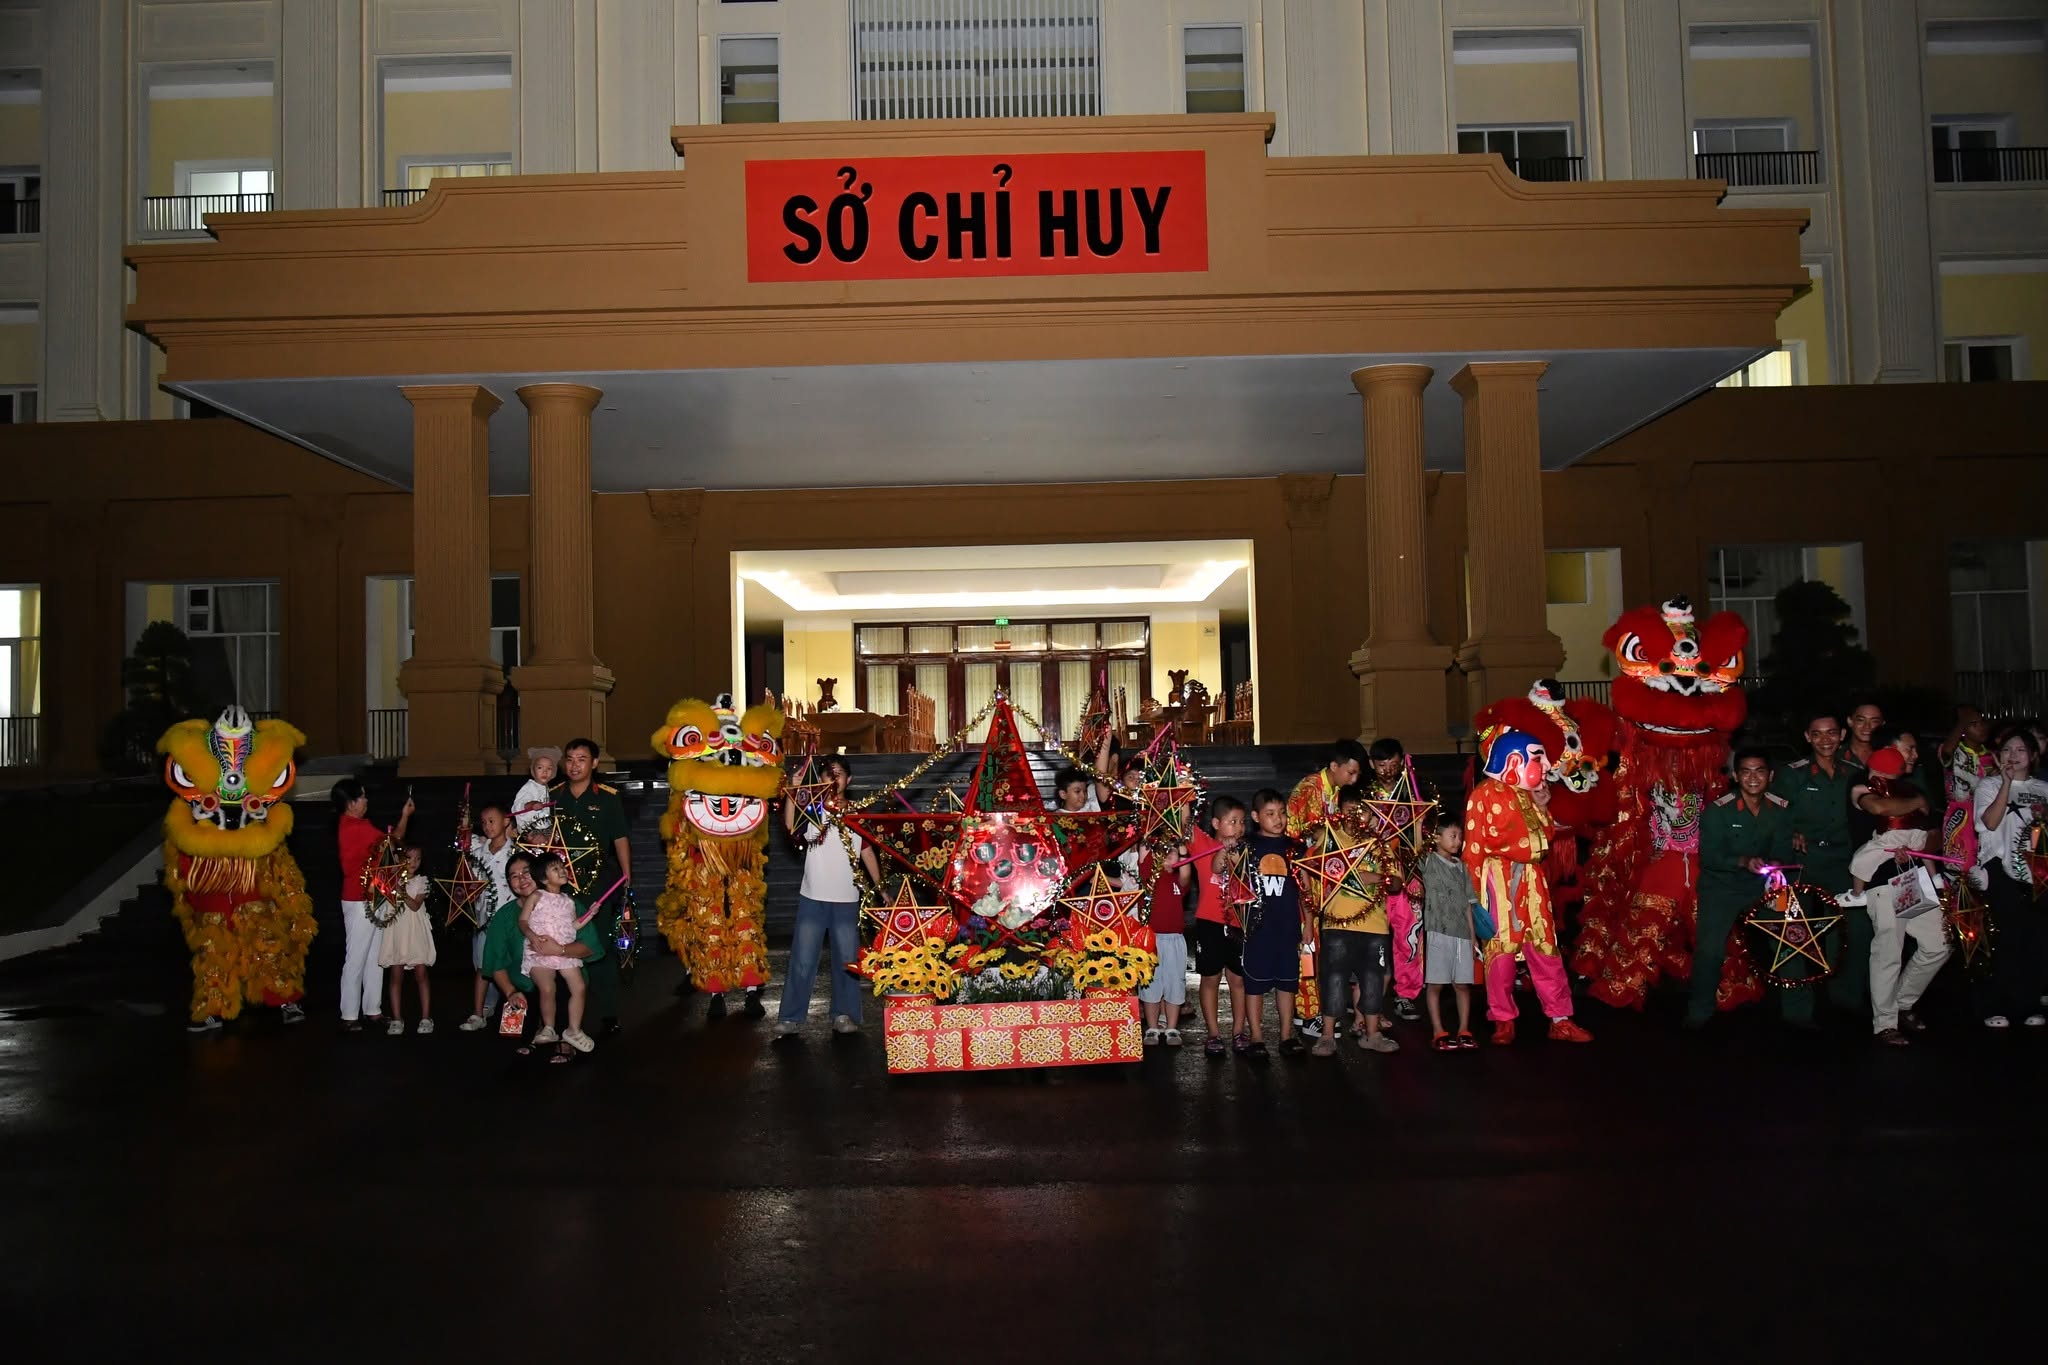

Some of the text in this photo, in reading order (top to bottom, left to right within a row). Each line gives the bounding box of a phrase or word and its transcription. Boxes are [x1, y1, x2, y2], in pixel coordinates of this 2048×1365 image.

[782, 163, 1172, 264] SỞ CHỈ HUY
[1262, 875, 1286, 897] W
